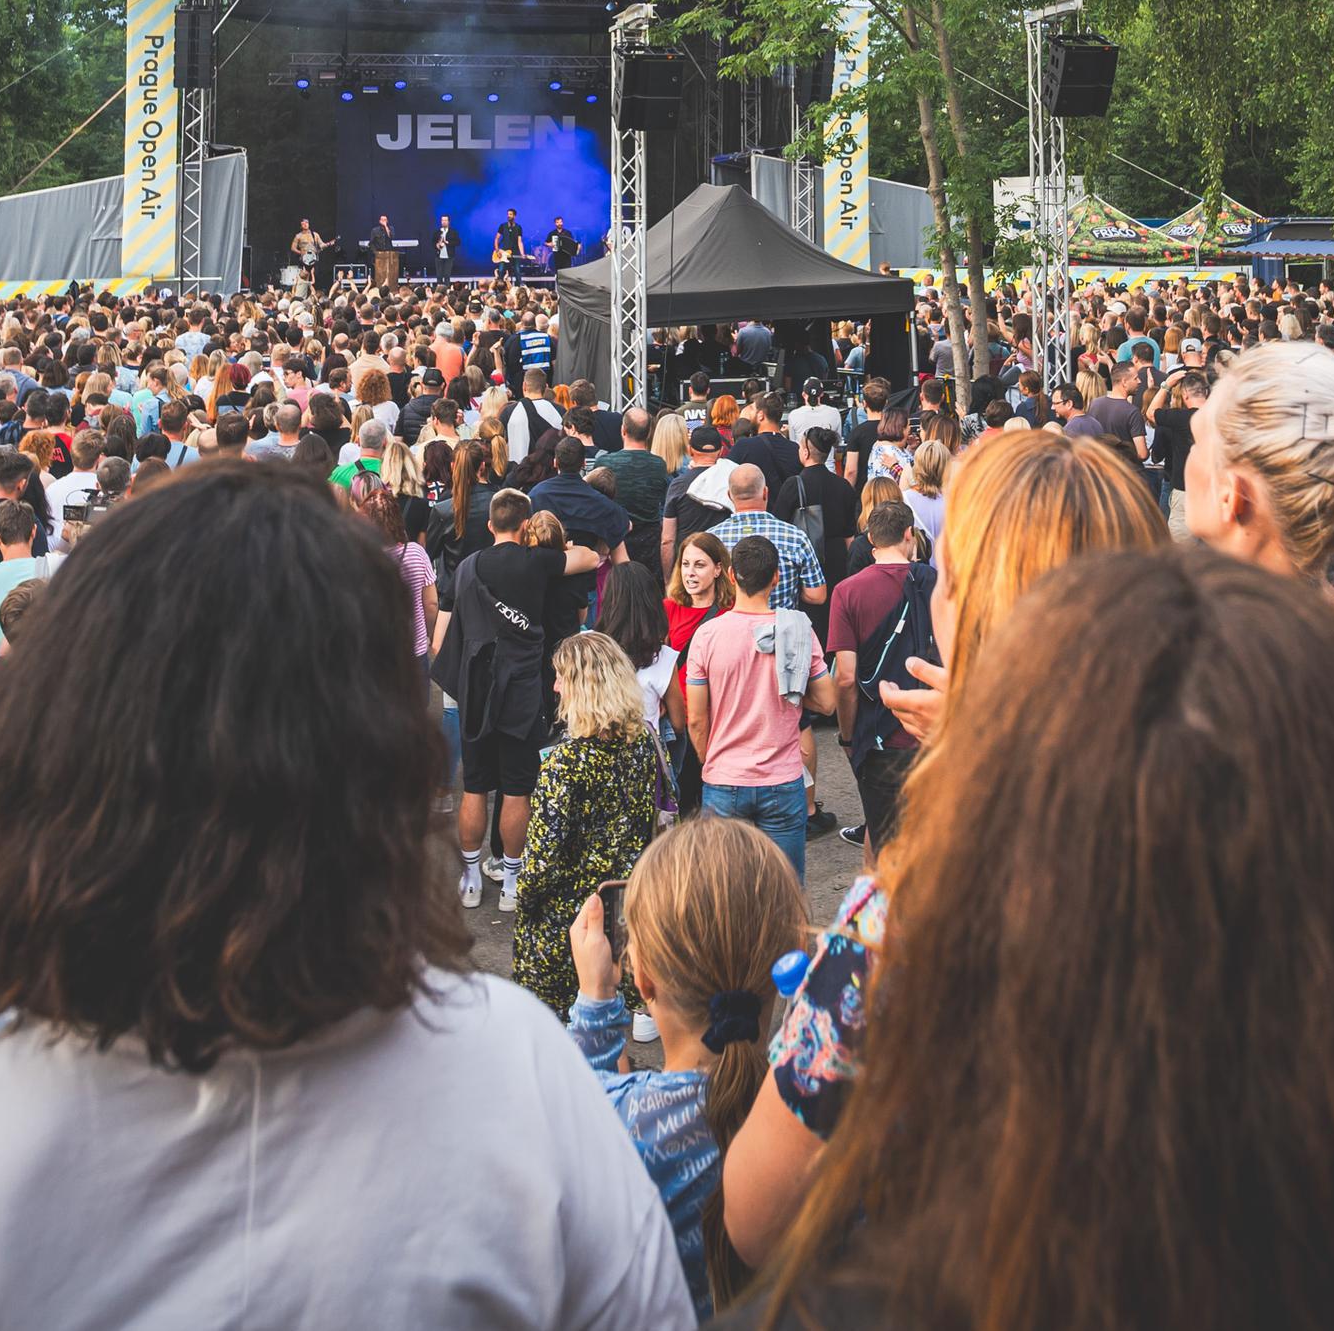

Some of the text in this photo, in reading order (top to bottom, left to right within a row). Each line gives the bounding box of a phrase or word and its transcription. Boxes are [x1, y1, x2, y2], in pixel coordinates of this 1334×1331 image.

[138, 35, 164, 219] Prague Open Air
[376, 114, 576, 150] JELEN
[840, 199, 858, 230] Air
[1092, 226, 1137, 240] FRISCO
